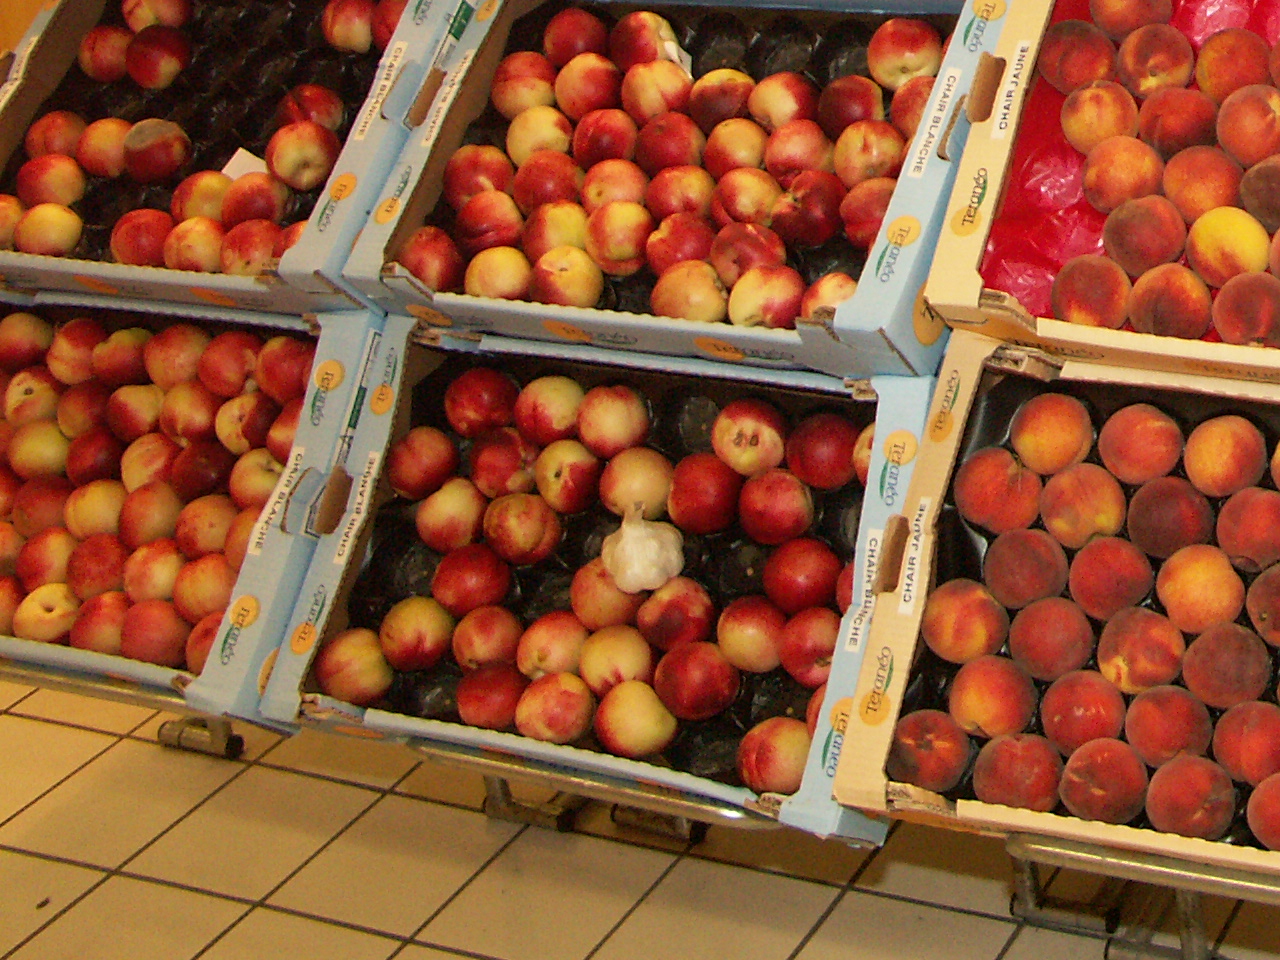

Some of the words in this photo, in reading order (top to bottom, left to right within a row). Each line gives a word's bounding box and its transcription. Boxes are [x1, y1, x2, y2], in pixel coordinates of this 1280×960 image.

[935, 75, 956, 114] CHAIR
[999, 89, 1016, 130] CHAIR
[1014, 46, 1029, 88] JAUNE
[913, 115, 939, 173] BLANCHE
[903, 554, 916, 603] CHAIR
[913, 503, 927, 552] JAUNE
